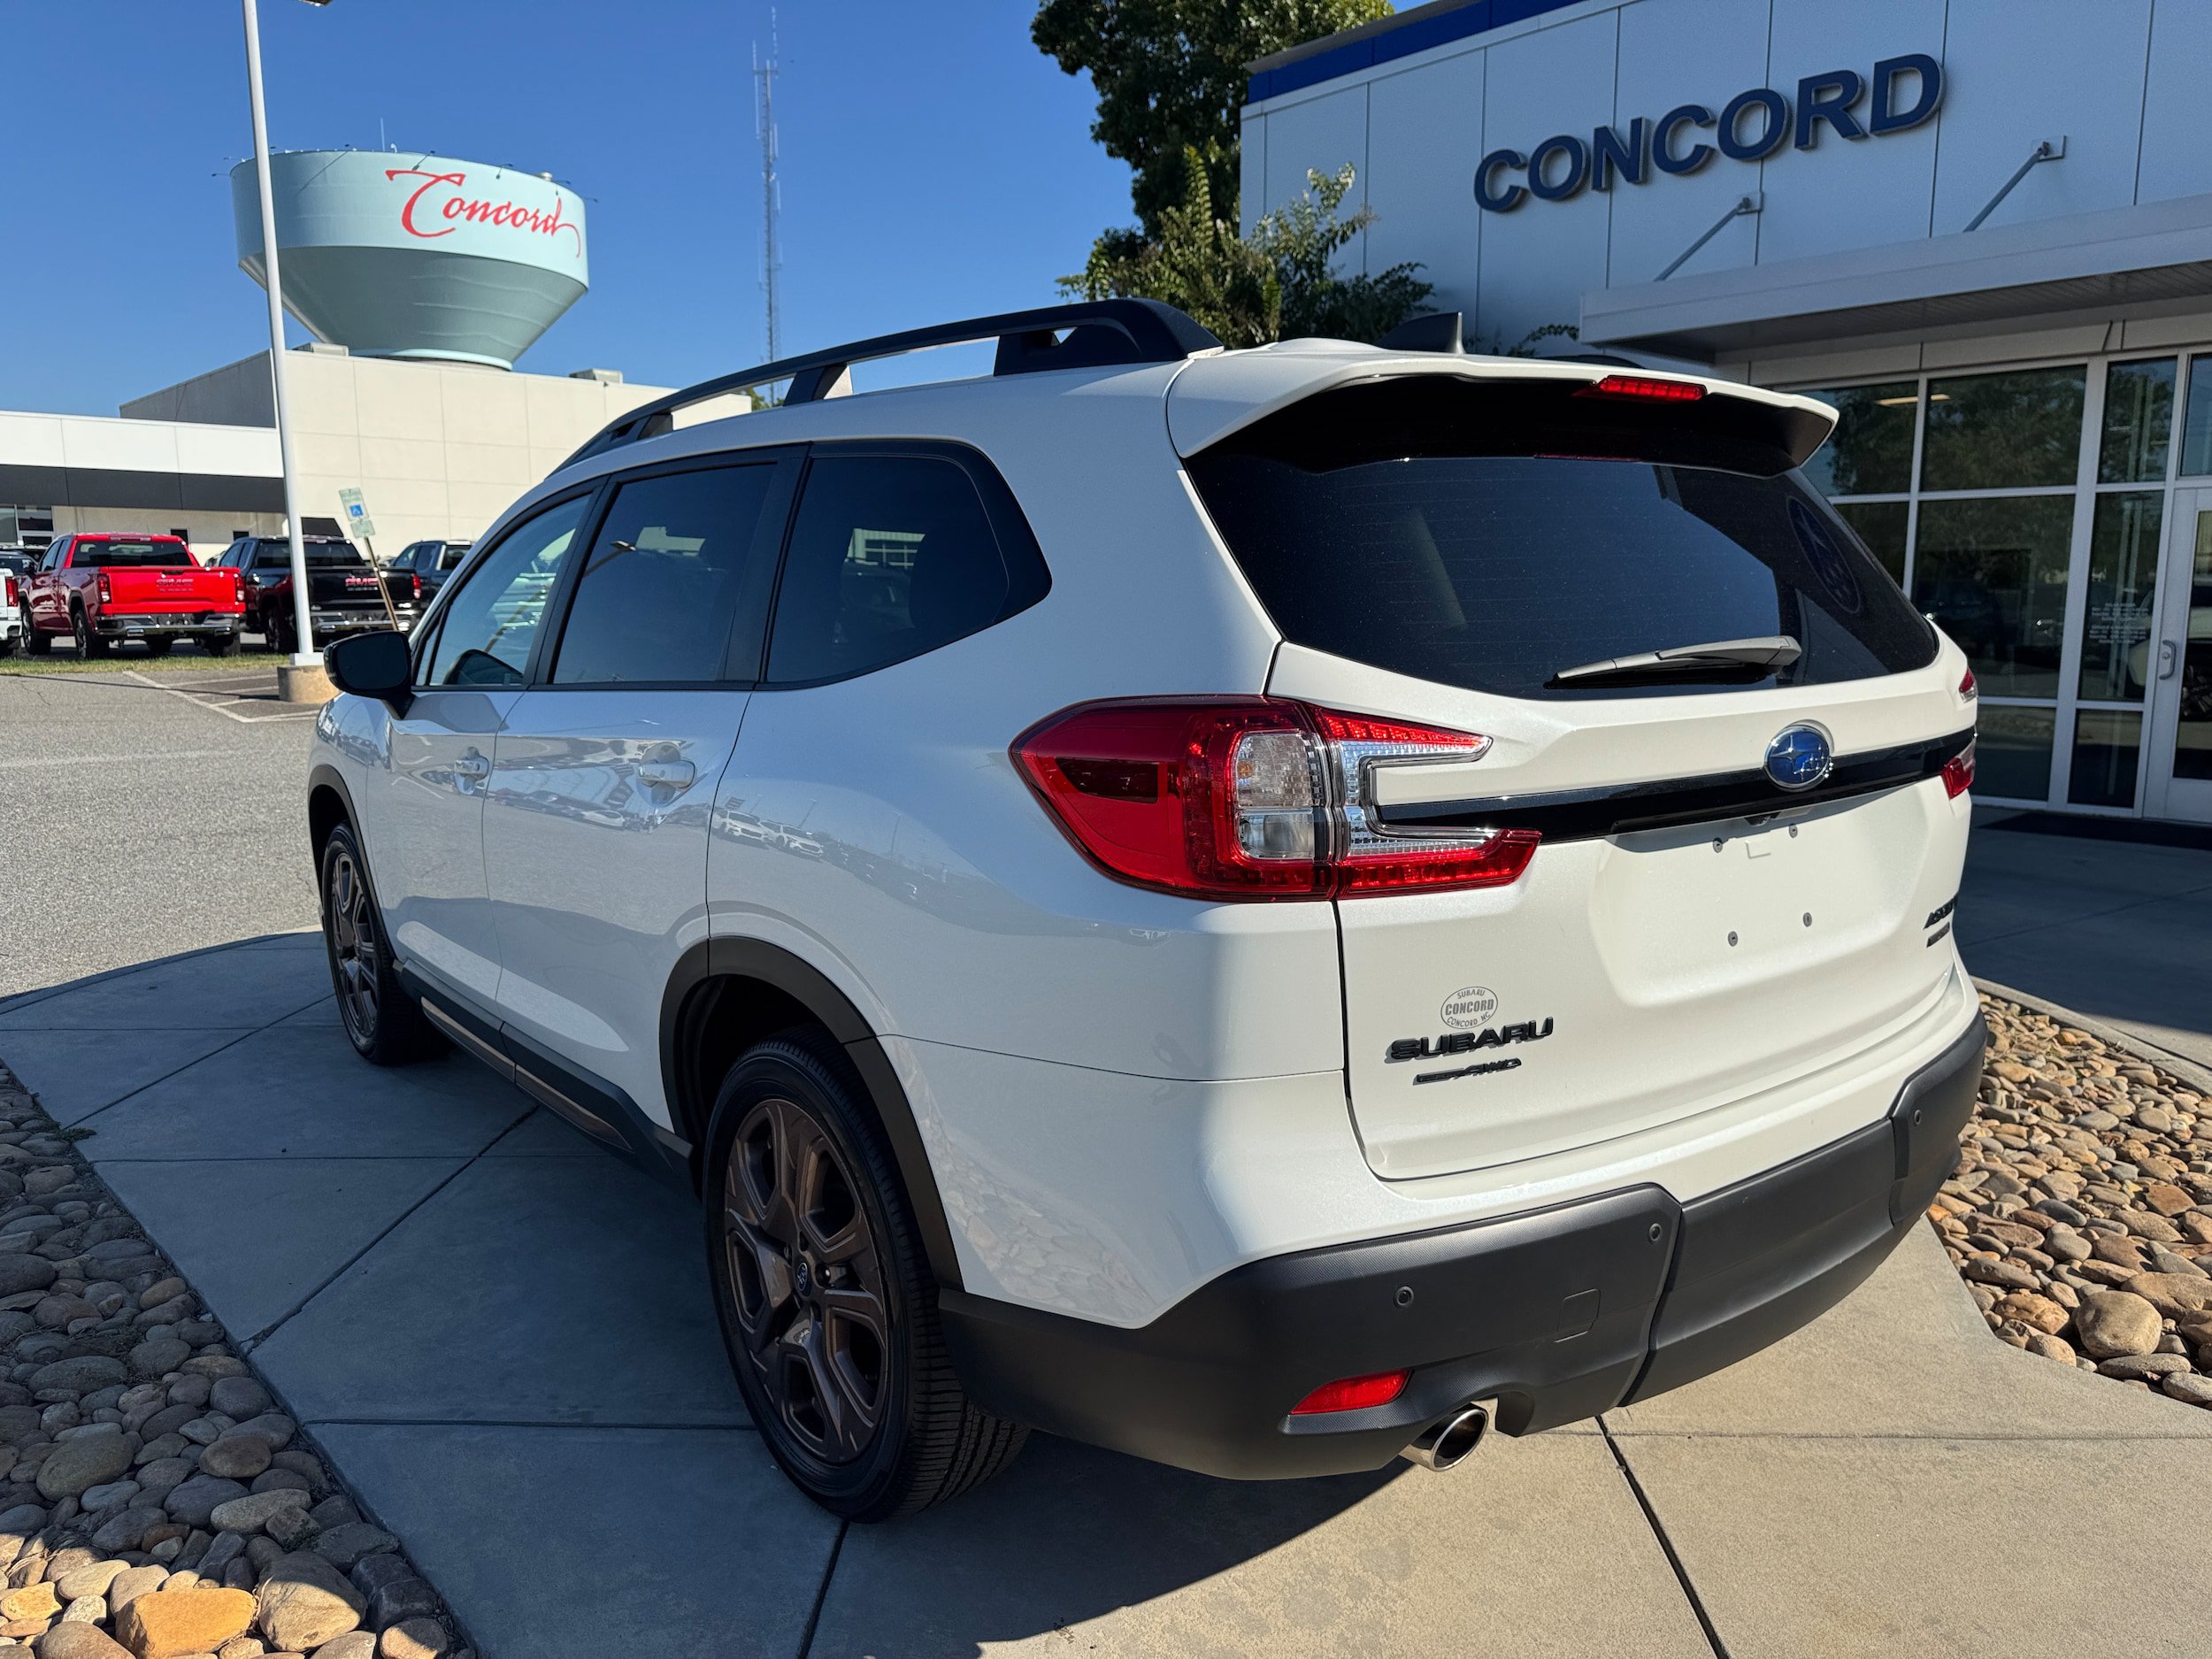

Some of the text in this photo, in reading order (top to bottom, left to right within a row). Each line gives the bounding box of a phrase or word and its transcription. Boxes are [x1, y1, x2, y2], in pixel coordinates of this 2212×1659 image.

[1473, 52, 1945, 213] CONCORD
[385, 169, 580, 258] Concord
[1456, 988, 1486, 999] SUBARU
[1445, 999, 1494, 1016] CONCORD
[1447, 1011, 1491, 1027] CONCORD NC
[1389, 1017, 1554, 1061] SUBARU
[1463, 1057, 1522, 1077] AWD
